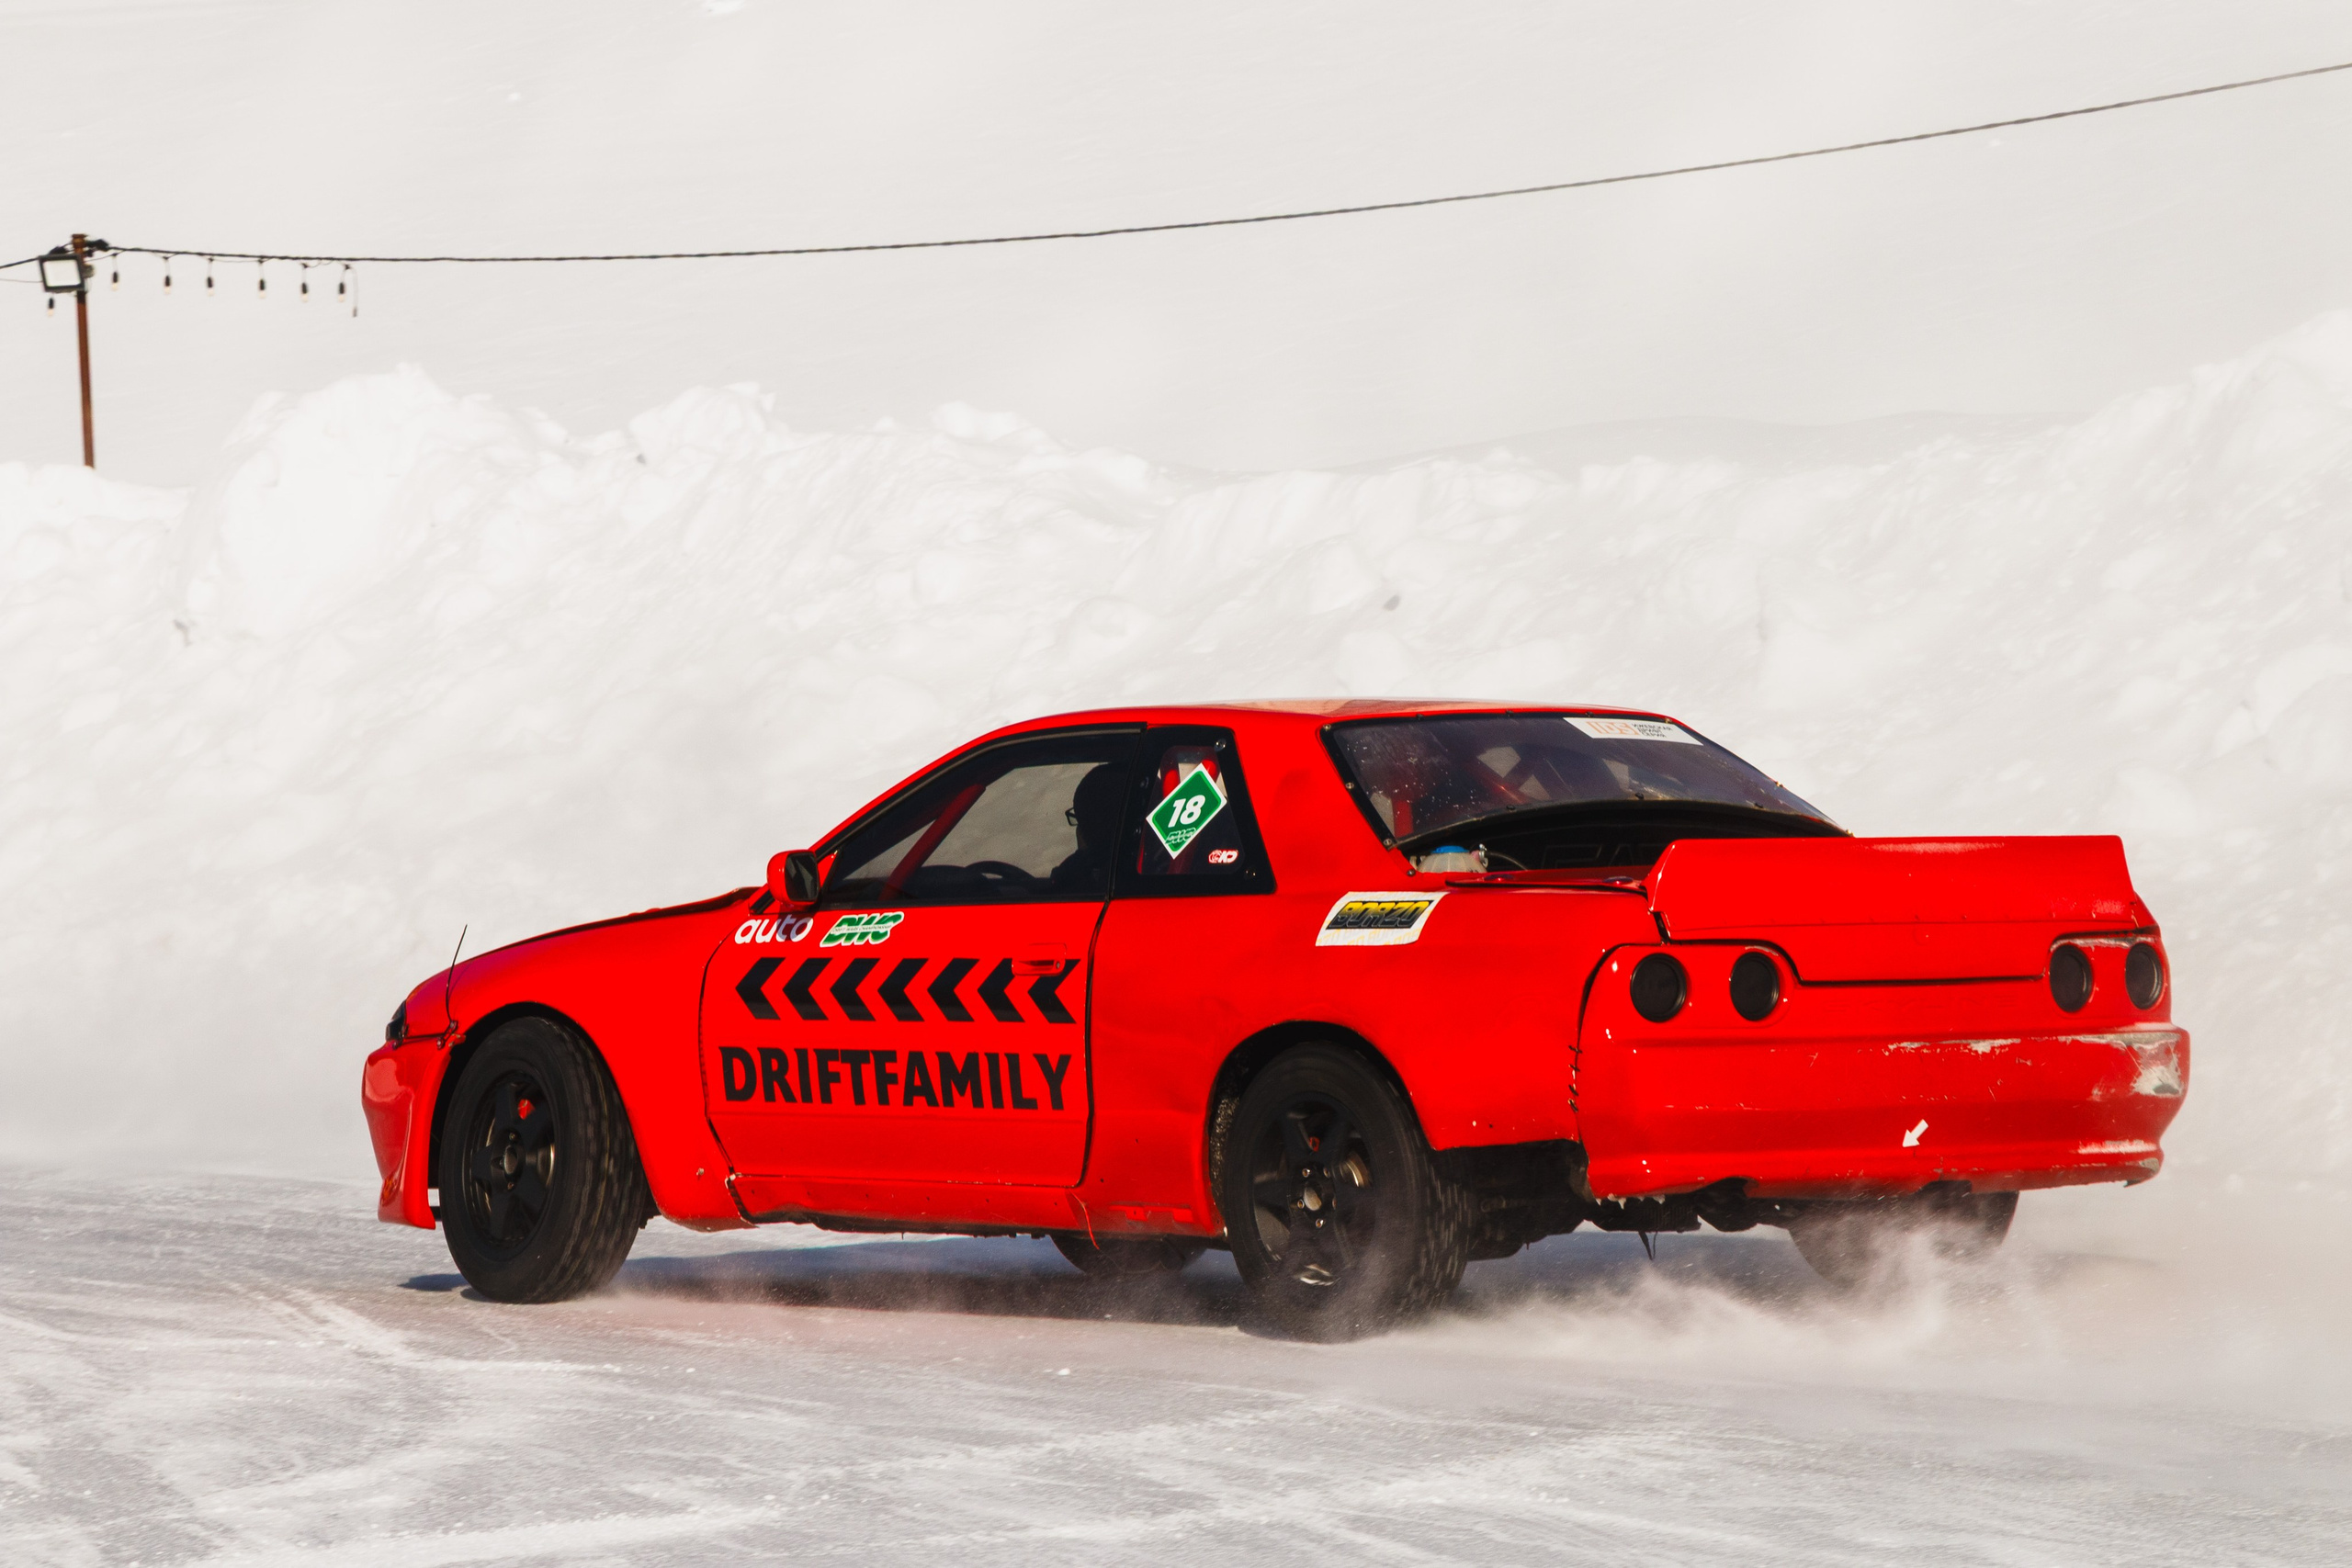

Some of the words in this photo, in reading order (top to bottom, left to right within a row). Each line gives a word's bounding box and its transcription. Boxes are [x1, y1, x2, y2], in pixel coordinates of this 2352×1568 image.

[1168, 795, 1206, 828] 18
[734, 915, 813, 944] auto
[1328, 901, 1430, 928] BORZO
[718, 1046, 1071, 1111] DRIFTFAMILY
